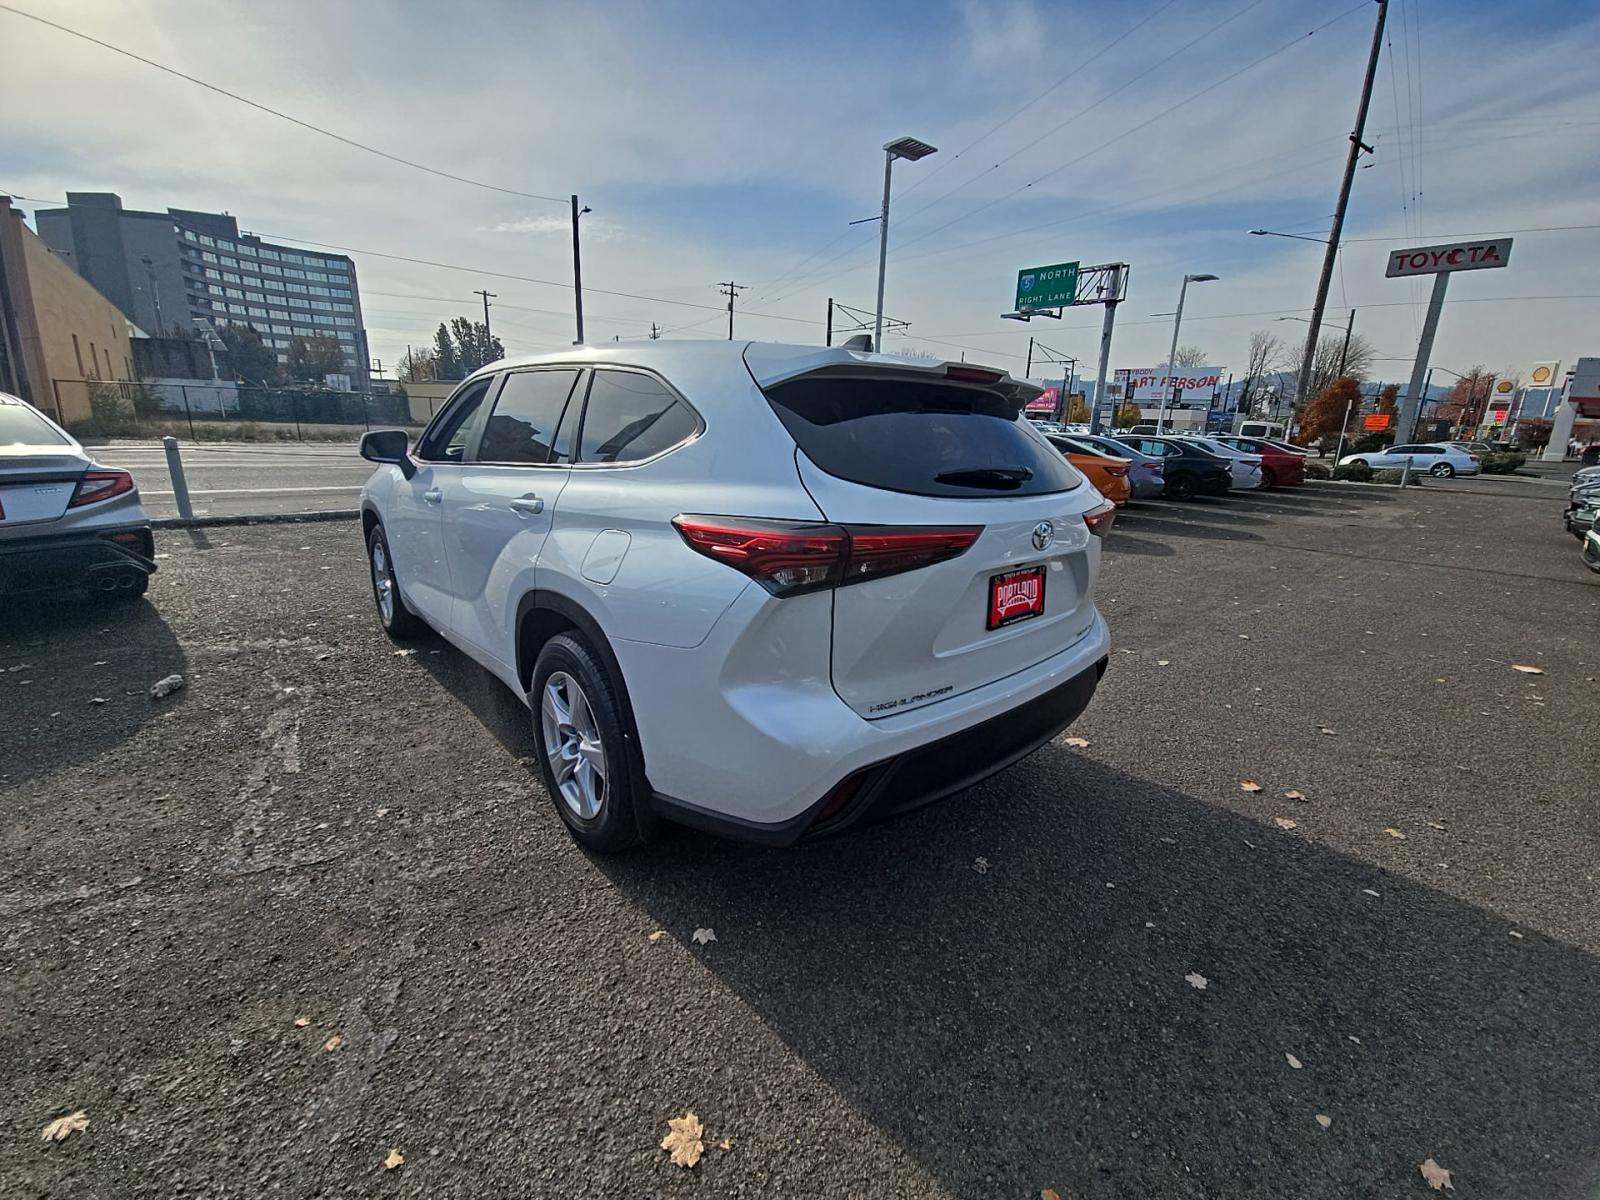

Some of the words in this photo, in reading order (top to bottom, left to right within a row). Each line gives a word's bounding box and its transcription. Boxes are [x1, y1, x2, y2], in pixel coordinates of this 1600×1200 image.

[1040, 268, 1076, 280] NORTH
[1019, 295, 1043, 304] RIGHT
[1048, 291, 1072, 301] LANE
[1130, 376, 1157, 388] ART
[997, 578, 1038, 608] PORTLAND
